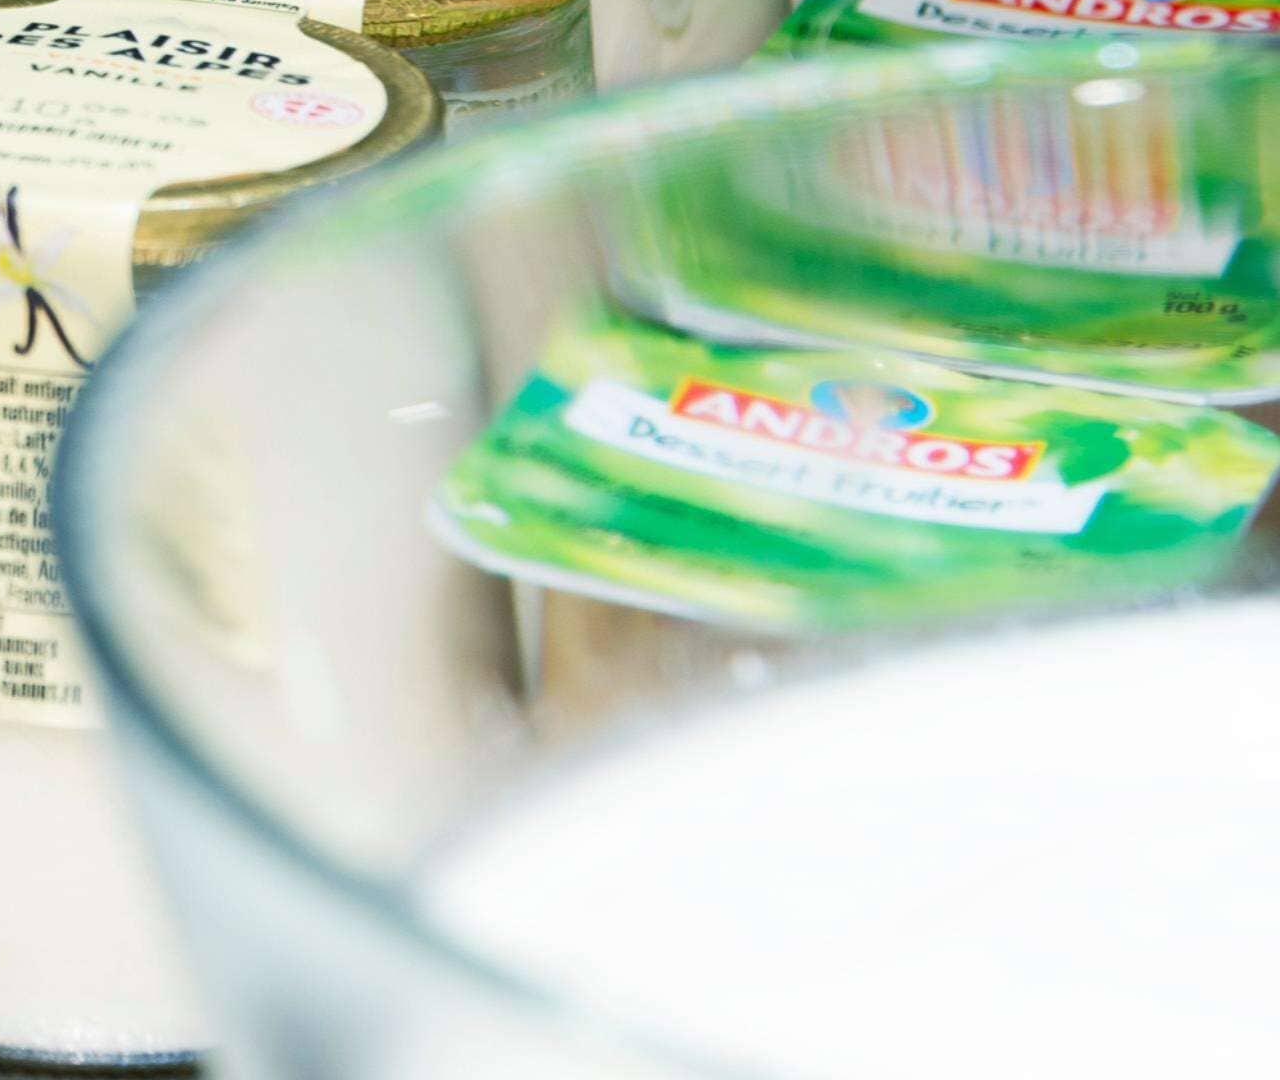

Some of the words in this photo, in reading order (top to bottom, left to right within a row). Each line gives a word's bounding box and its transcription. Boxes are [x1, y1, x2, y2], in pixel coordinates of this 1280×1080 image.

[21, 21, 283, 70] PLAISIR
[106, 45, 311, 87] ALPES
[29, 62, 201, 92] VANILLE
[677, 389, 1024, 478] ANDROS
[626, 413, 811, 490] Dessert
[830, 464, 1006, 513] Fruitier
